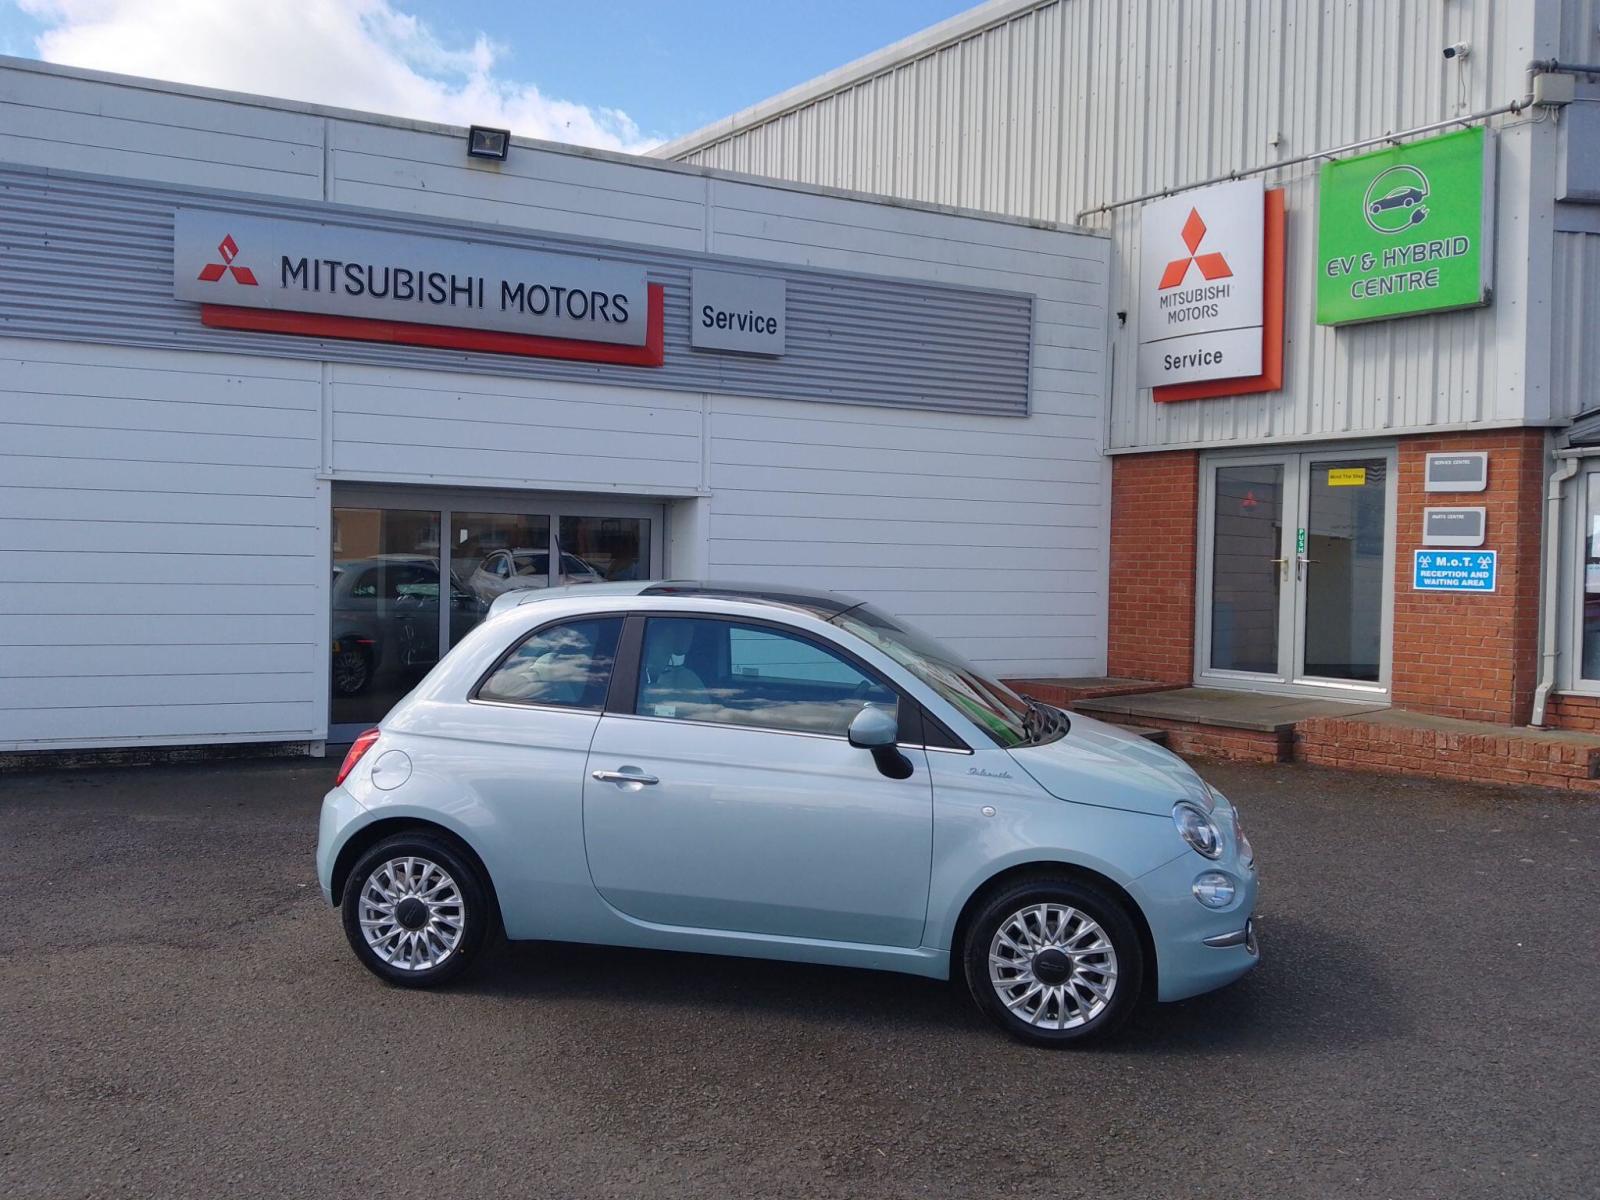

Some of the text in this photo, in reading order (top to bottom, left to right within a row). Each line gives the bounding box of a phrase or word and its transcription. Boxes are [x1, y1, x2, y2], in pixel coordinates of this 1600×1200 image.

[1327, 236, 1469, 277] EV & HYBRID
[279, 254, 630, 324] MITSUBISHI MOTORS
[1351, 269, 1440, 300] CENTRE
[1159, 285, 1231, 309] MITSUBISHI
[701, 304, 778, 335] Service
[1167, 303, 1219, 325] MOTORS
[1163, 349, 1224, 371] Service
[1435, 556, 1473, 567] M.o.T.
[1420, 570, 1490, 579] RECEPTION AND
[1424, 578, 1485, 587] WAITING AREA
